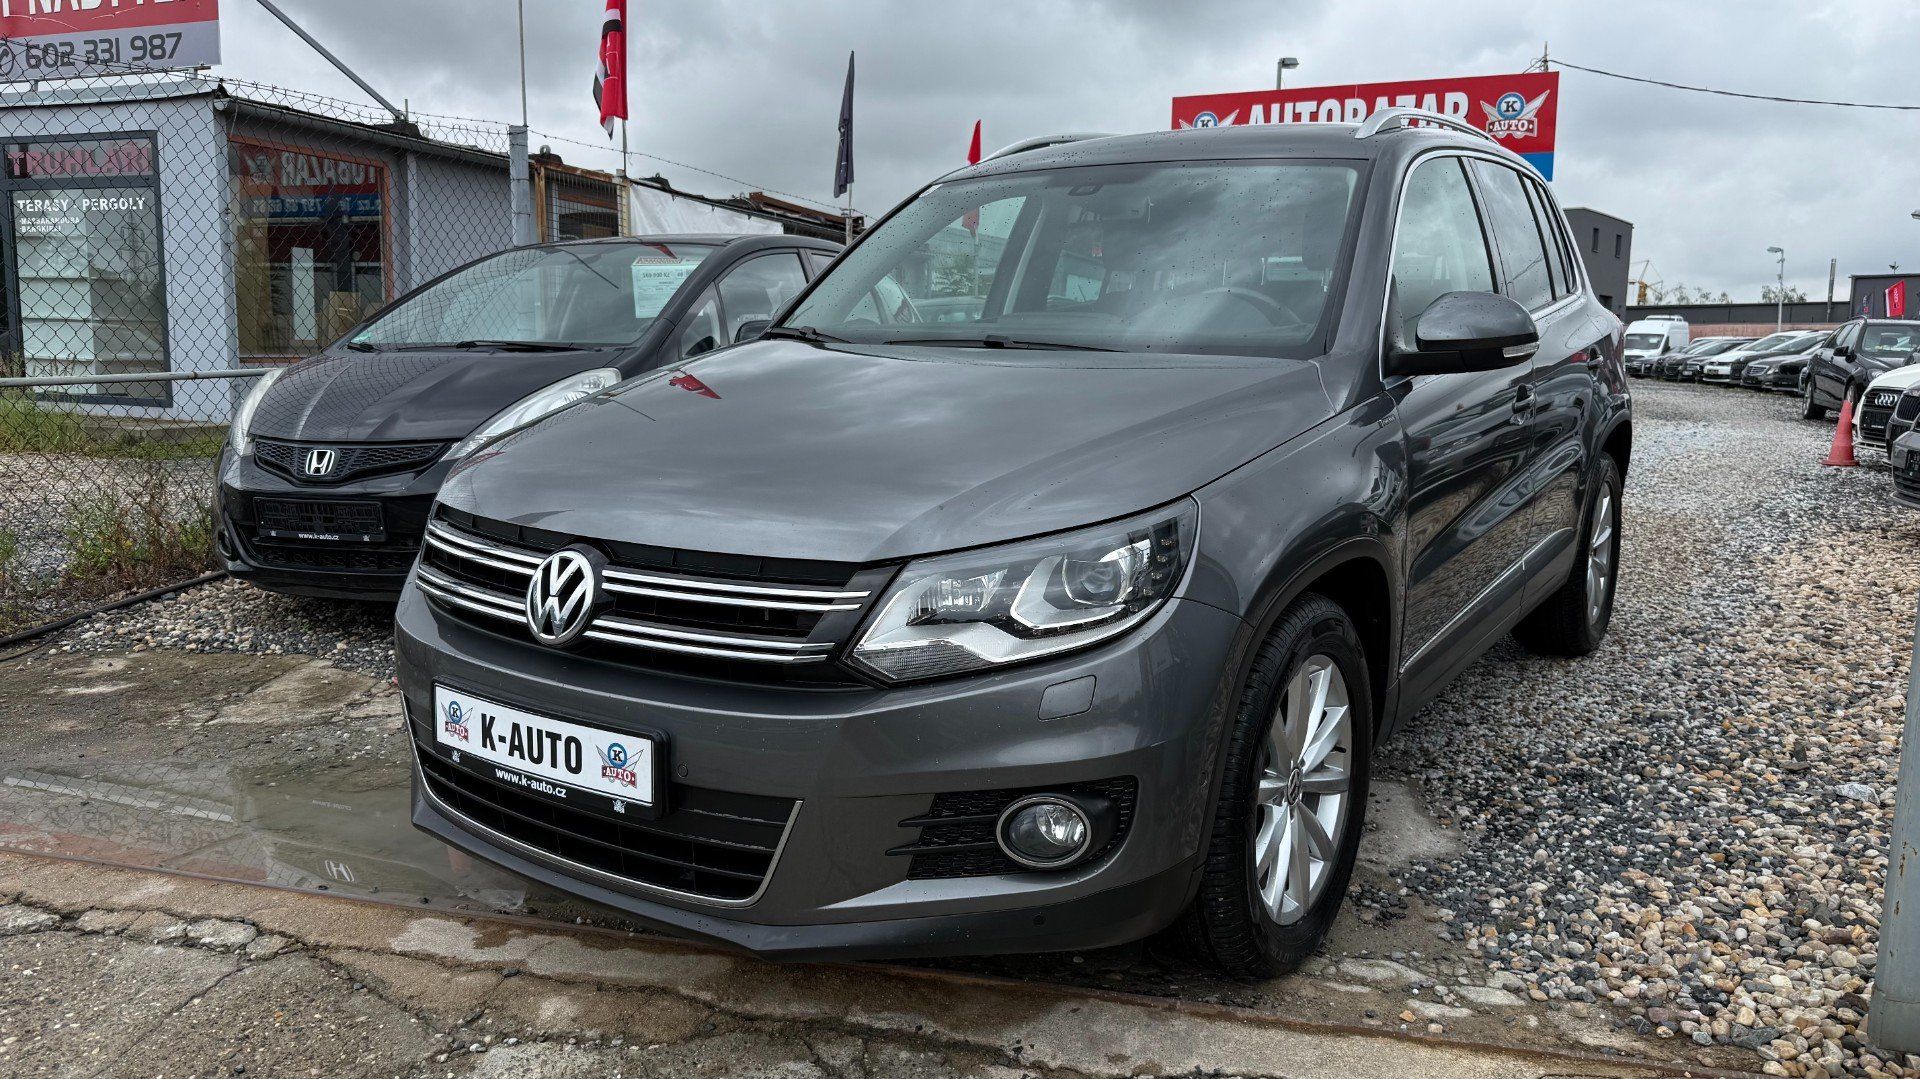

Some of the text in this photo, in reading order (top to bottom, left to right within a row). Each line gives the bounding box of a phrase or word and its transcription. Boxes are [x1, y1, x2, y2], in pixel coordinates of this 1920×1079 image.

[25, 31, 183, 70] 602 331 987
[1503, 100, 1518, 113] K
[1492, 119, 1529, 132] AUTO
[17, 197, 146, 212] TERASY PERGOLY
[451, 706, 460, 719] K
[448, 722, 466, 737] AUTO
[481, 713, 583, 775] K-AUTO
[611, 749, 623, 762] K
[605, 766, 632, 782] AUTO
[495, 768, 567, 799] www.k-auto.cz
